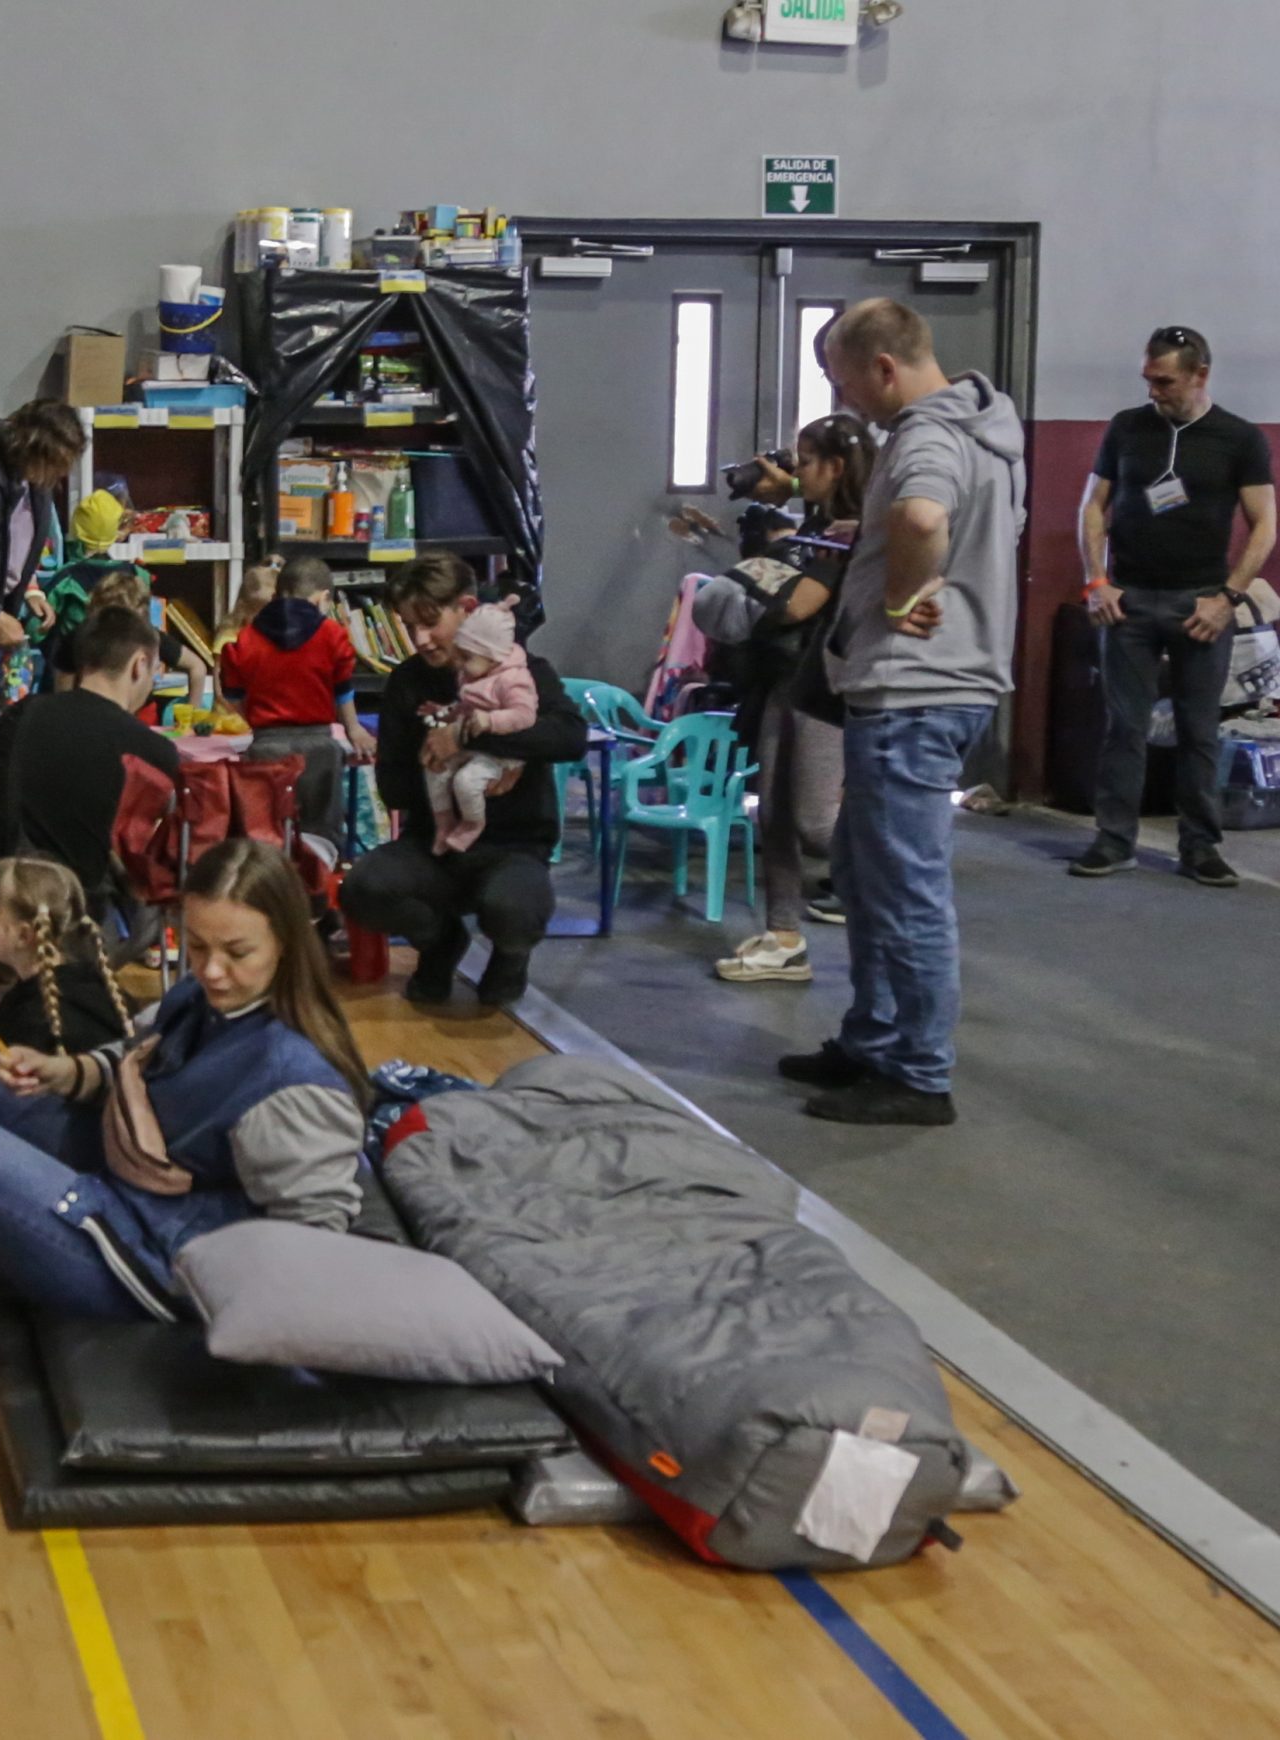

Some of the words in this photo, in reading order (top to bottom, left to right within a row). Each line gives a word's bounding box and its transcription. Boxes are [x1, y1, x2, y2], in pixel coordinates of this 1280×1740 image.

[780, 0, 845, 20] SALIDA
[773, 159, 811, 171] SALIDA
[813, 160, 827, 171] DE
[766, 172, 833, 184] EMERGENCIA
